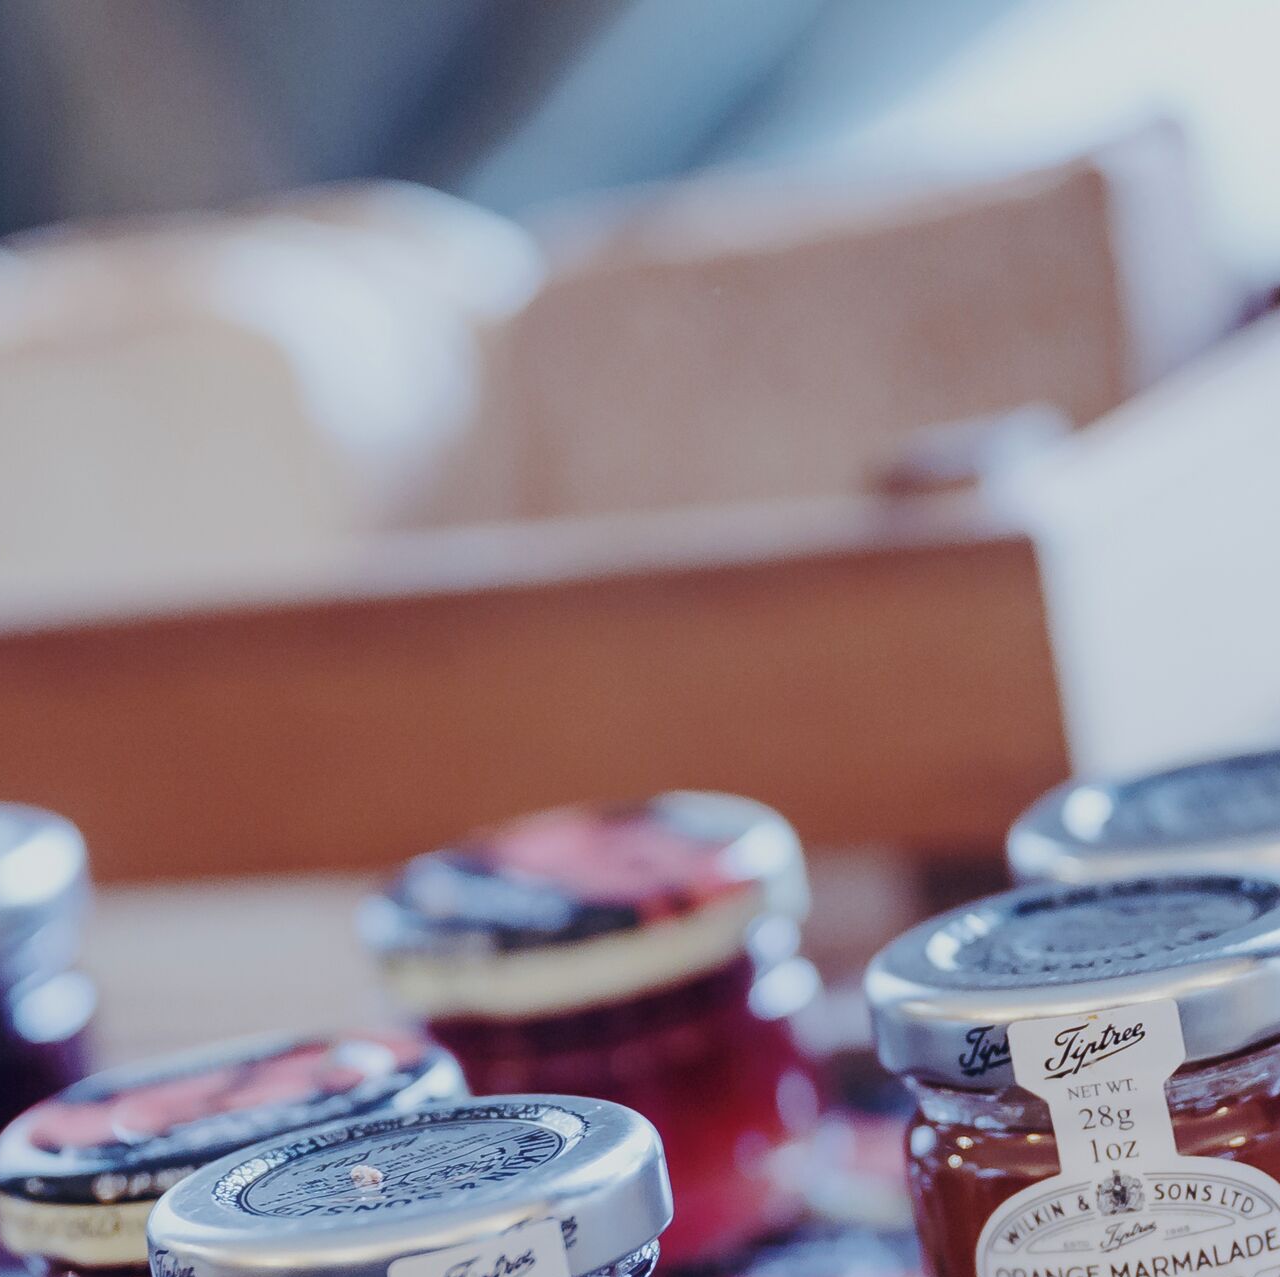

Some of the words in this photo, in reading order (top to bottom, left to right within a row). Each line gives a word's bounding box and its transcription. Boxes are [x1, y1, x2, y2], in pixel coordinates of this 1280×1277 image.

[1044, 1022, 1147, 1081] Tiptree
[1067, 1083, 1101, 1101] NET
[1107, 1078, 1138, 1094] WT.
[1079, 1105, 1136, 1132] 28g
[479, 1129, 556, 1181] WILKIN
[1091, 1139, 1140, 1164] 1oz
[1002, 1200, 1065, 1247] WILKIN
[1078, 1195, 1091, 1212] &
[1154, 1182, 1213, 1202] SONS
[1220, 1188, 1256, 1214] LTD
